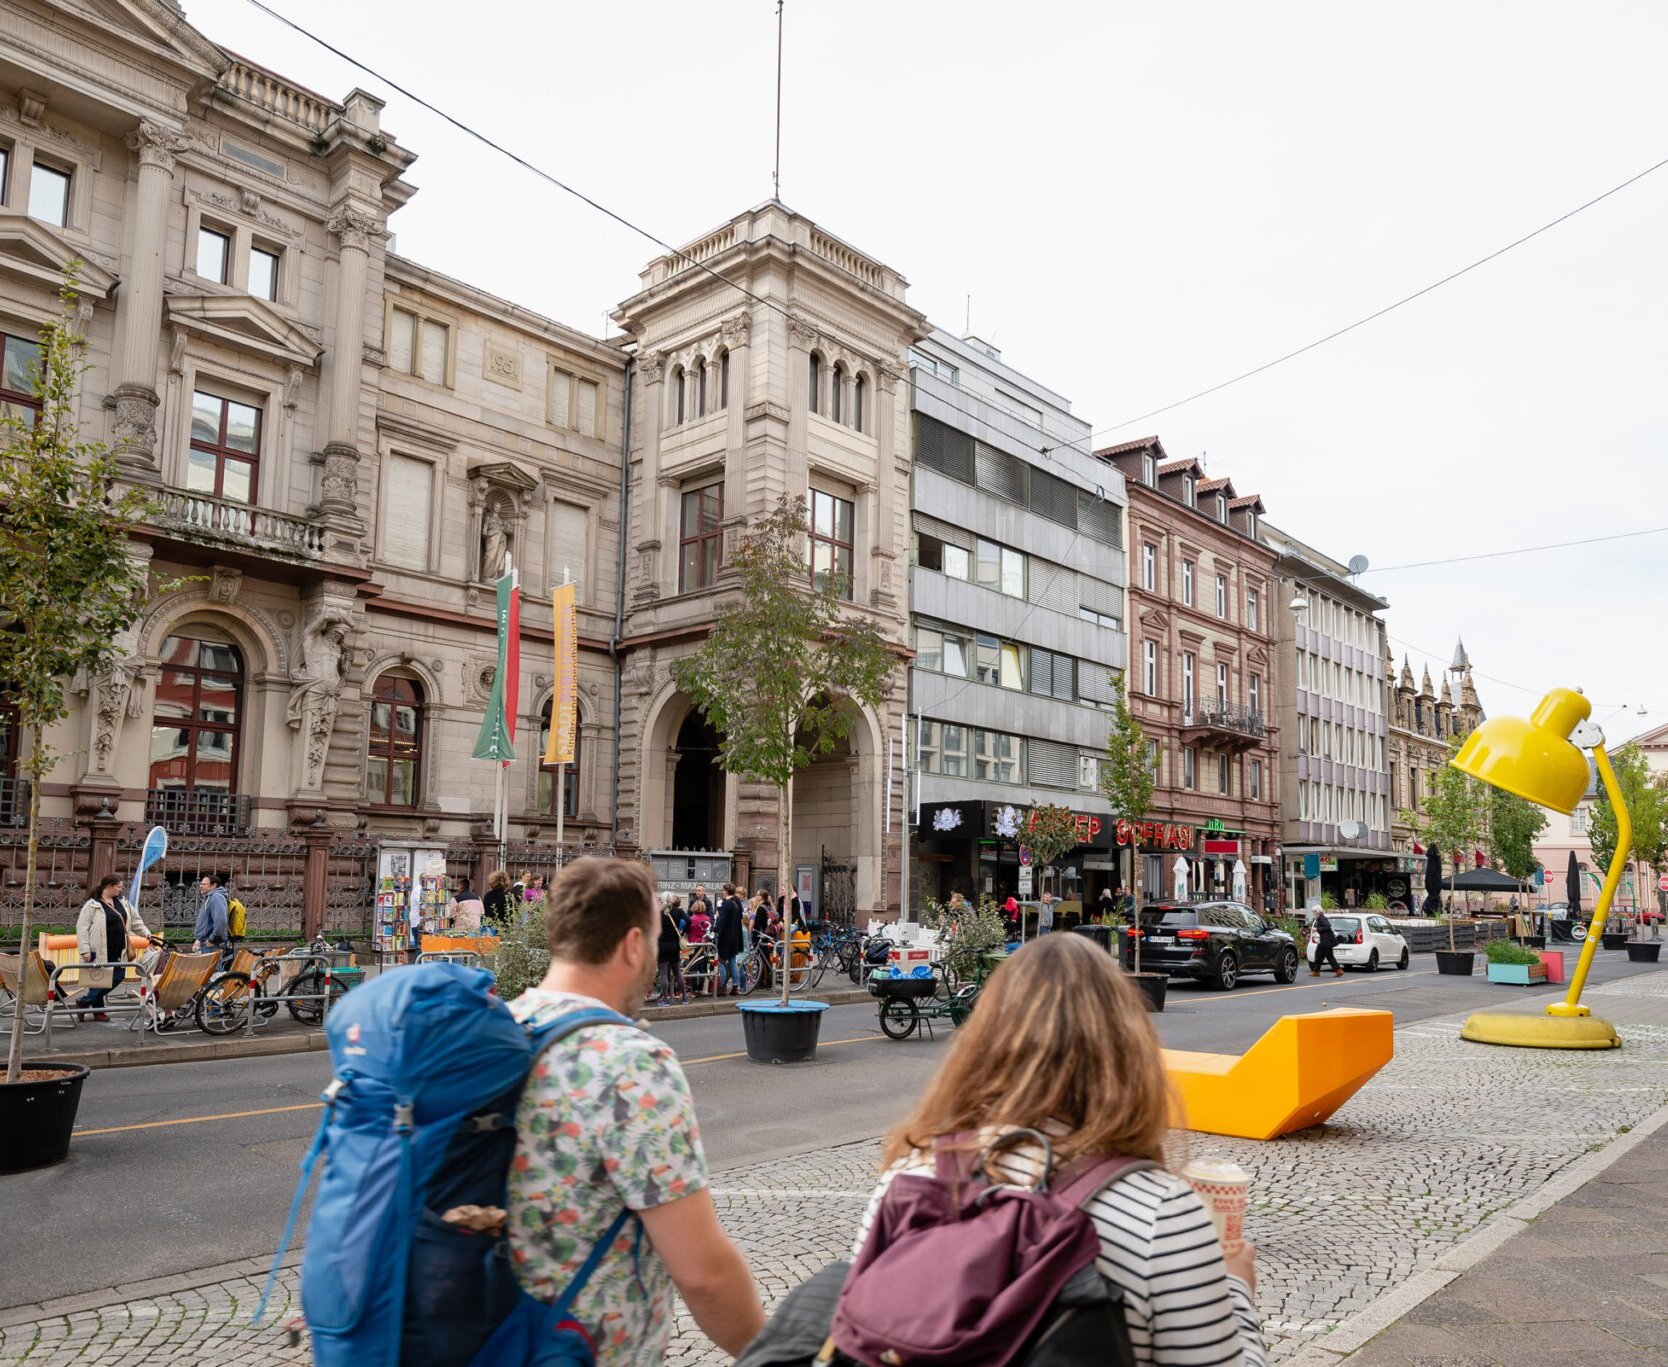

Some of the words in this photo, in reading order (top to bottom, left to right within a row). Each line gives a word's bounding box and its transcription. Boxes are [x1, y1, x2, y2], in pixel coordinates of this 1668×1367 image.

[490, 351, 519, 377] 1951
[570, 695, 578, 714] und
[657, 881, 676, 890] RINZ
